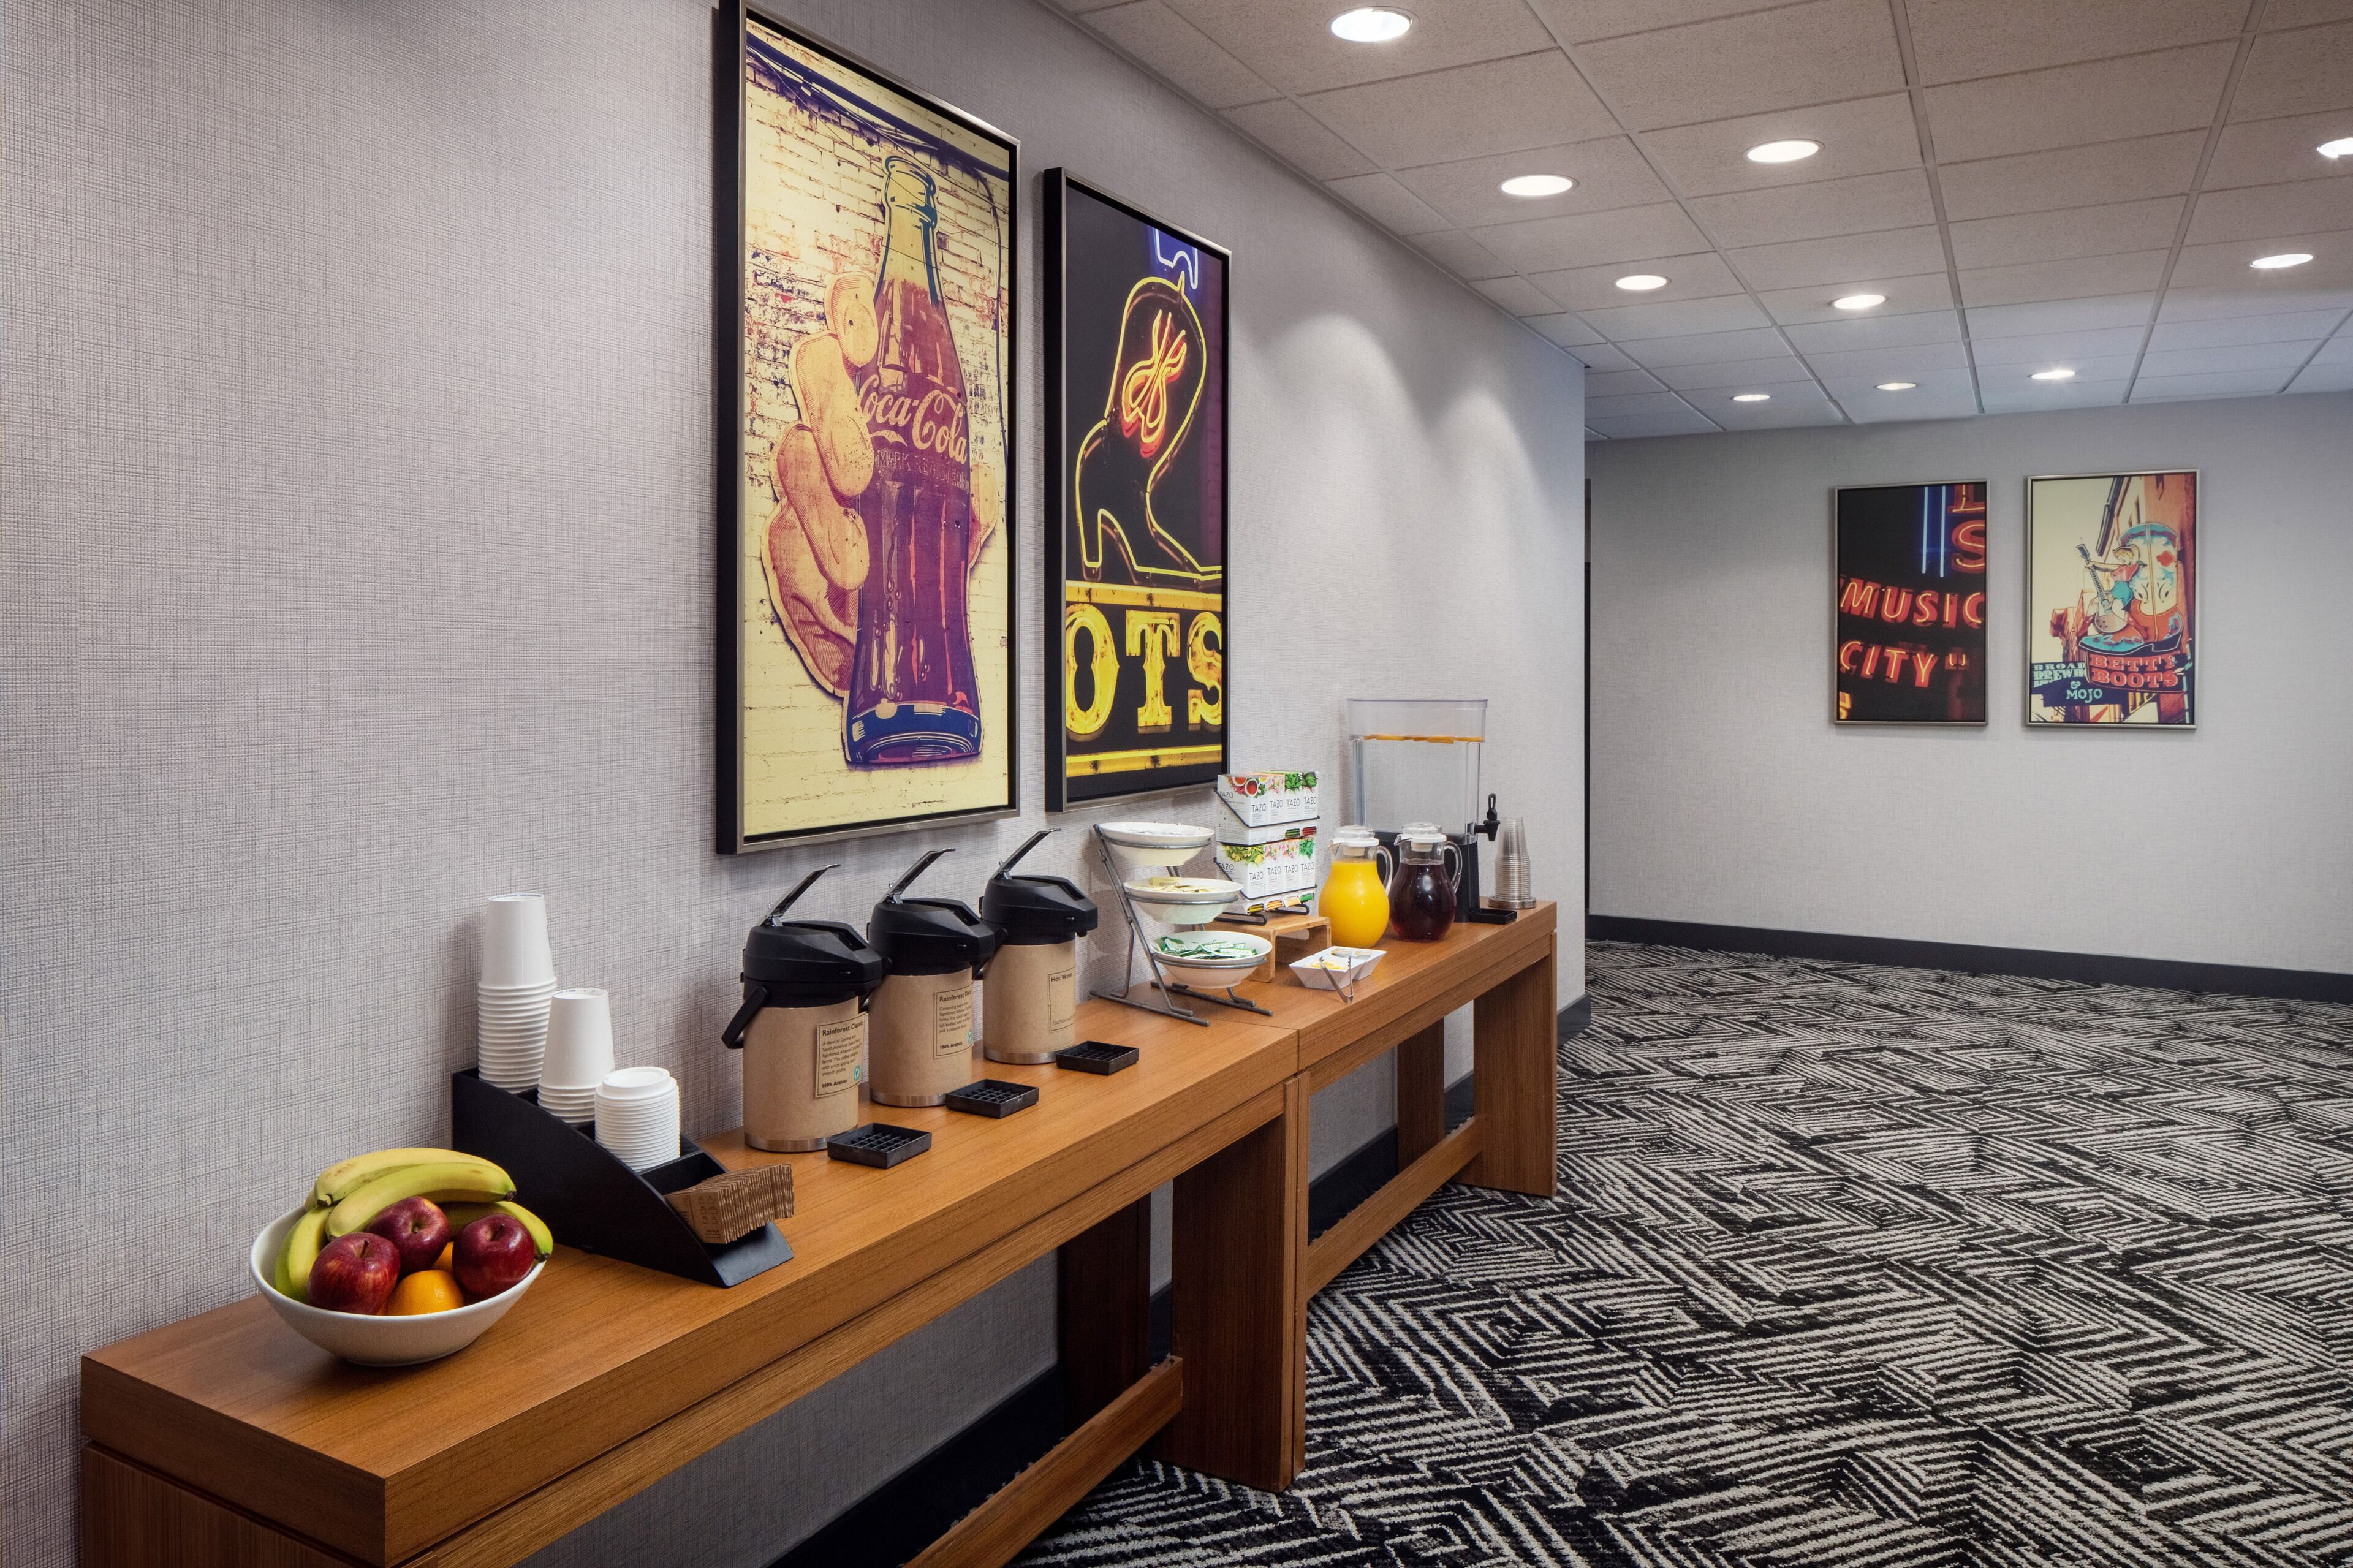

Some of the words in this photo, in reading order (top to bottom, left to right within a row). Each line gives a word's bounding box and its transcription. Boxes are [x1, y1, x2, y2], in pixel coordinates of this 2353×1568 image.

[858, 374, 968, 465] Coca-Cola
[1840, 578, 1985, 629] MUSIC
[1066, 603, 1222, 734] OTS
[1840, 640, 1939, 688] CITY
[2090, 654, 2174, 672] BETTY
[2091, 668, 2178, 688] BOOTS
[2066, 688, 2102, 703] MOJO
[1270, 799, 1283, 808] TAZO
[1303, 796, 1317, 805] TAZO
[1251, 803, 1267, 812] TAZO
[1267, 866, 1281, 875] TAZO
[1284, 864, 1298, 873] TAZO
[1301, 862, 1314, 871] TAZO
[1249, 871, 1264, 881] TAZO
[939, 993, 964, 1002] Rainforest
[822, 1026, 850, 1036] Rainforest
[851, 1021, 863, 1029] Classic
